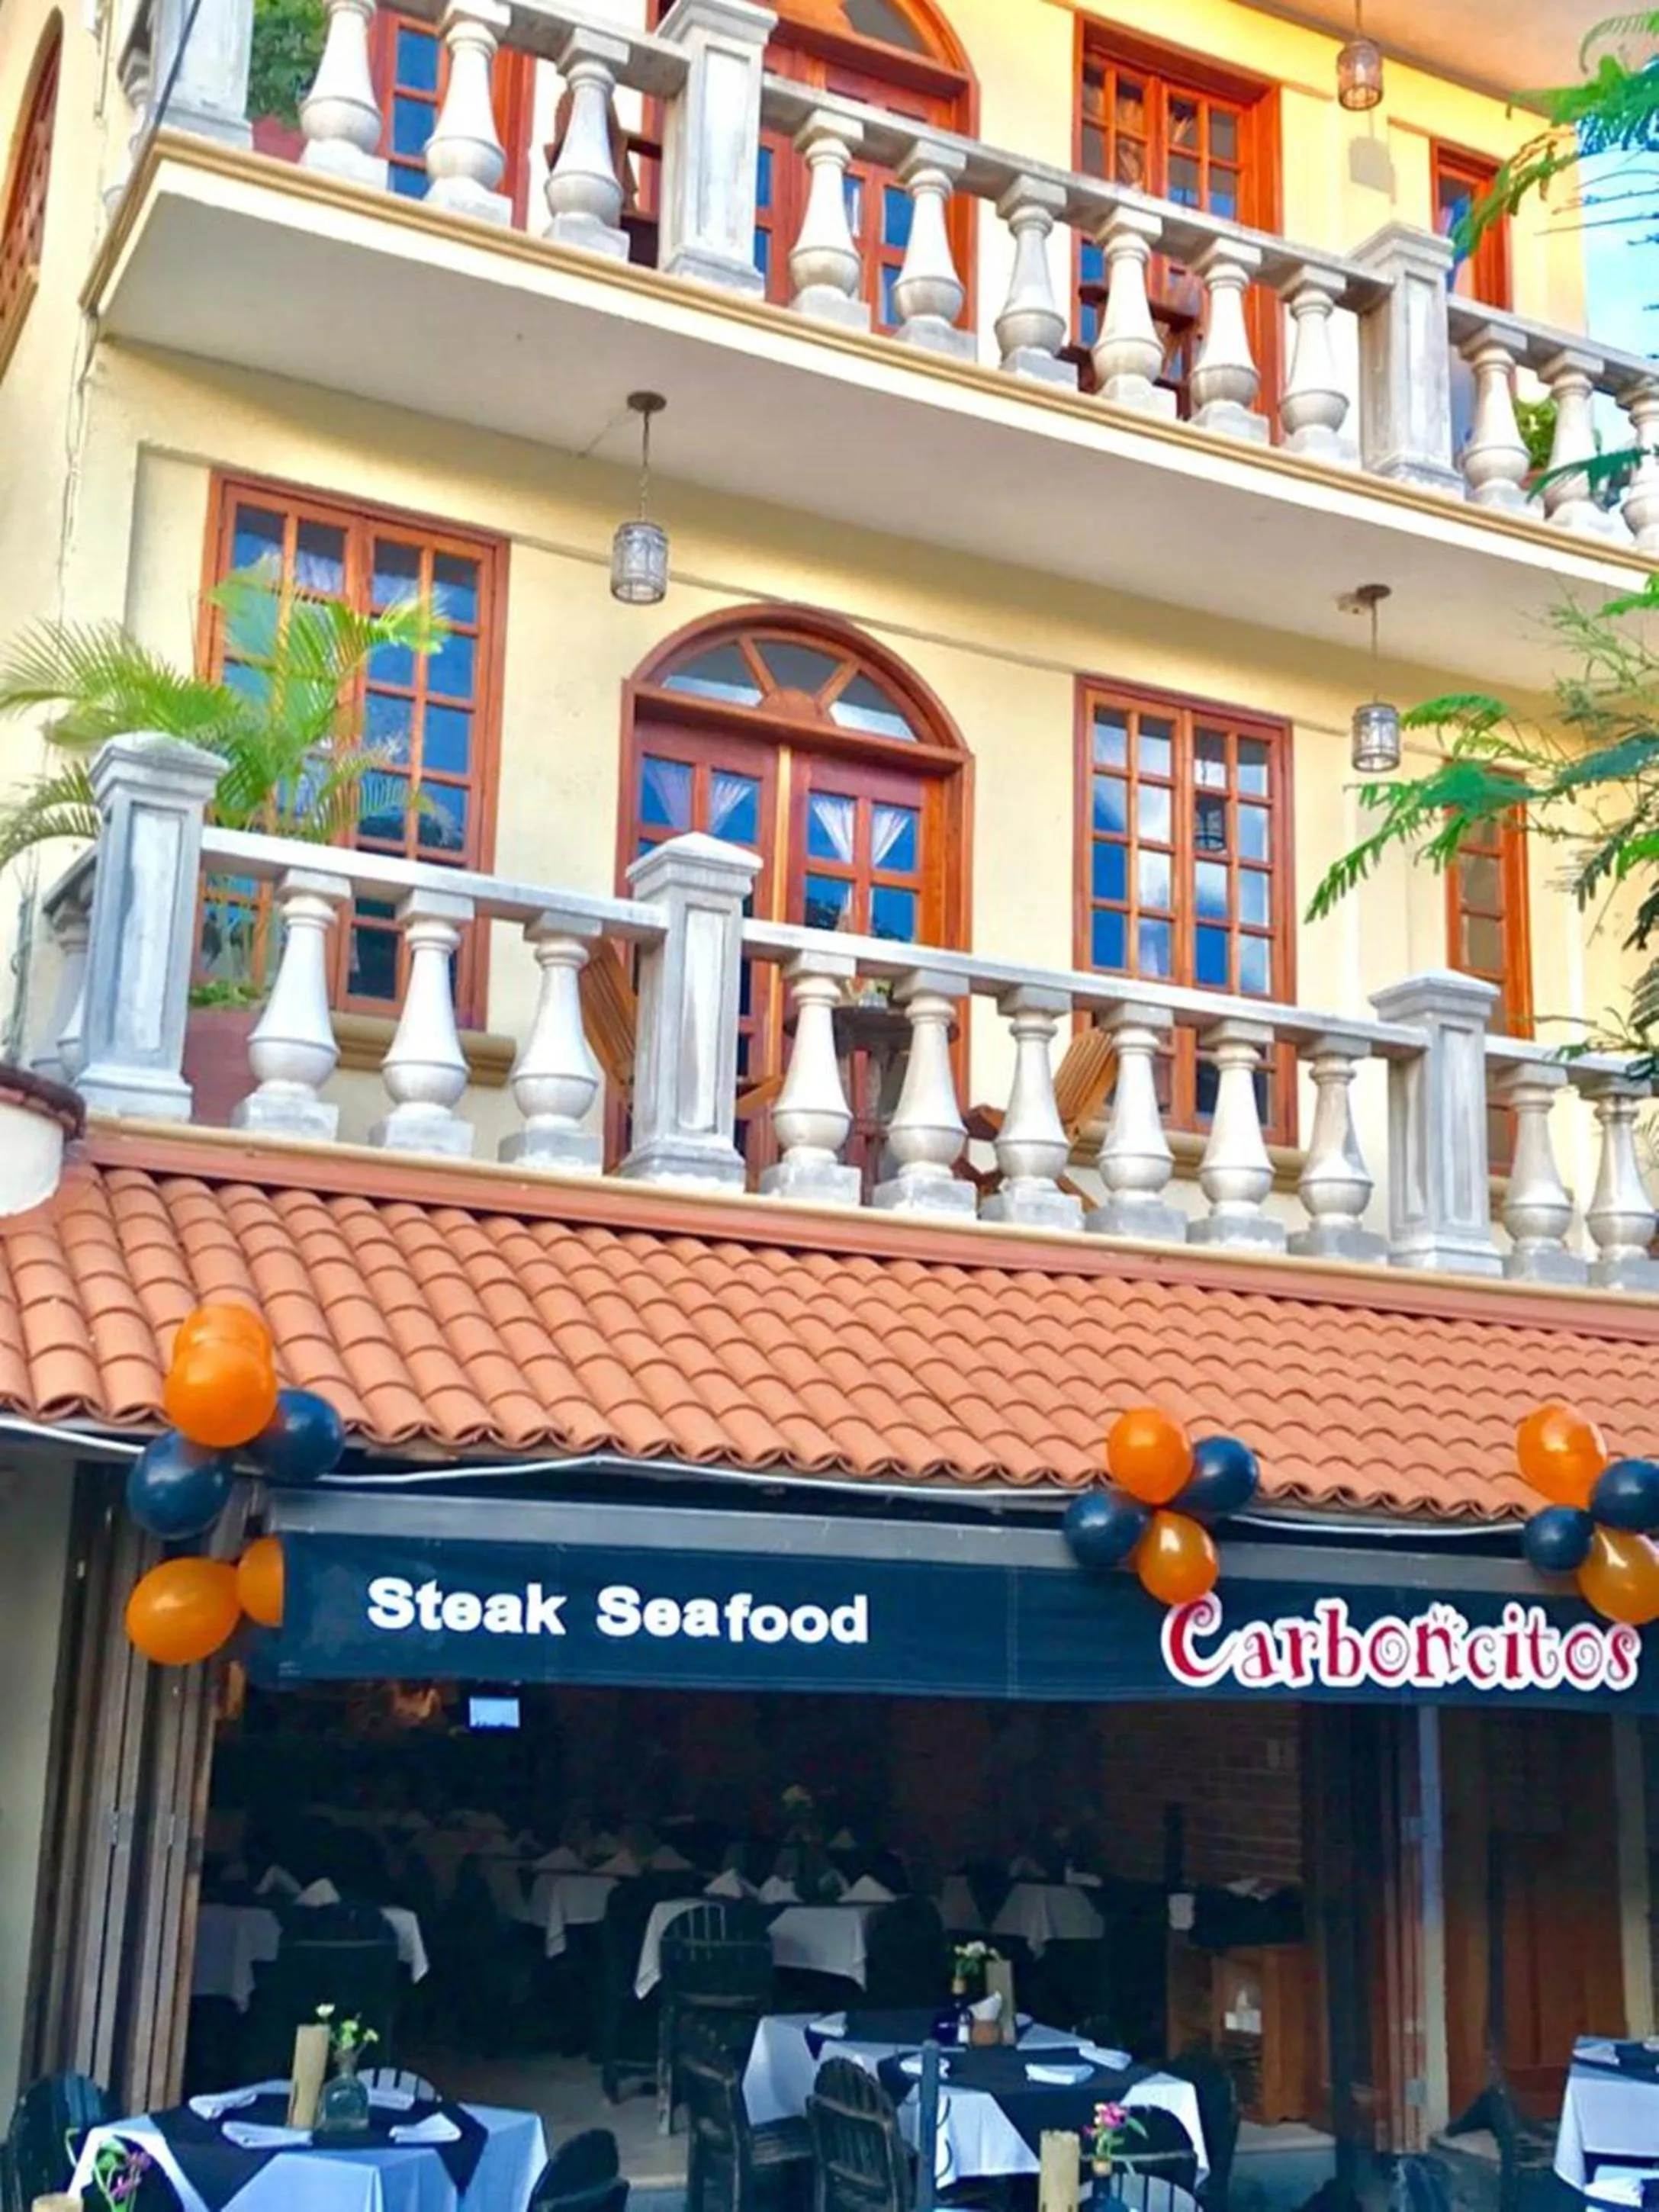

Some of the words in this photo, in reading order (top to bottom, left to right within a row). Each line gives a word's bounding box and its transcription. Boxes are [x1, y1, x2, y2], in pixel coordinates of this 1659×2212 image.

[368, 1577, 567, 1636] Steak
[596, 1586, 869, 1644] Seafood
[1162, 1593, 1641, 1689] Carboncitos
